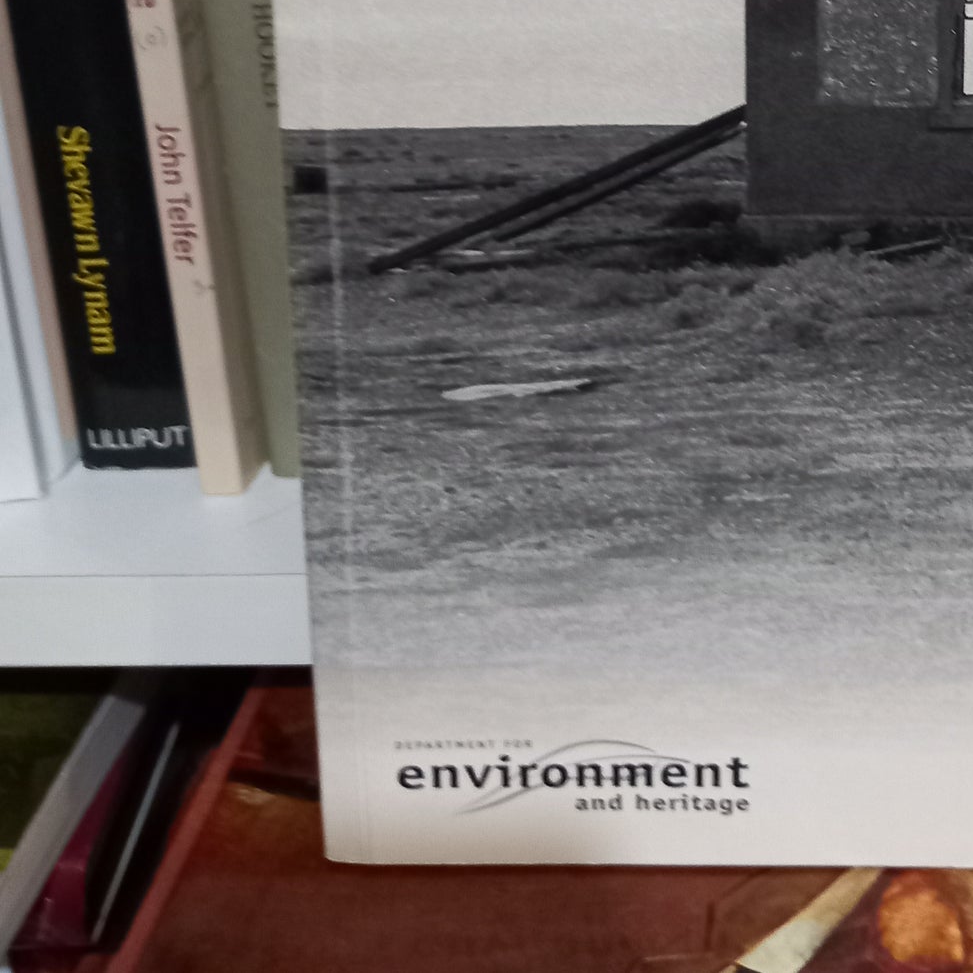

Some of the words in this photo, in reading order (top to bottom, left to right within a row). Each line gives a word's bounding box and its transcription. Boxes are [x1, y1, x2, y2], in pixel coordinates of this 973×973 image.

[156, 124, 187, 186] John
[57, 124, 100, 254] Shevawn
[165, 190, 199, 265] Telfer
[72, 256, 116, 355] Lynam
[86, 425, 189, 450] LILLIPUT
[397, 754, 751, 789] environment
[575, 794, 624, 811] and
[636, 794, 751, 815] heritage
